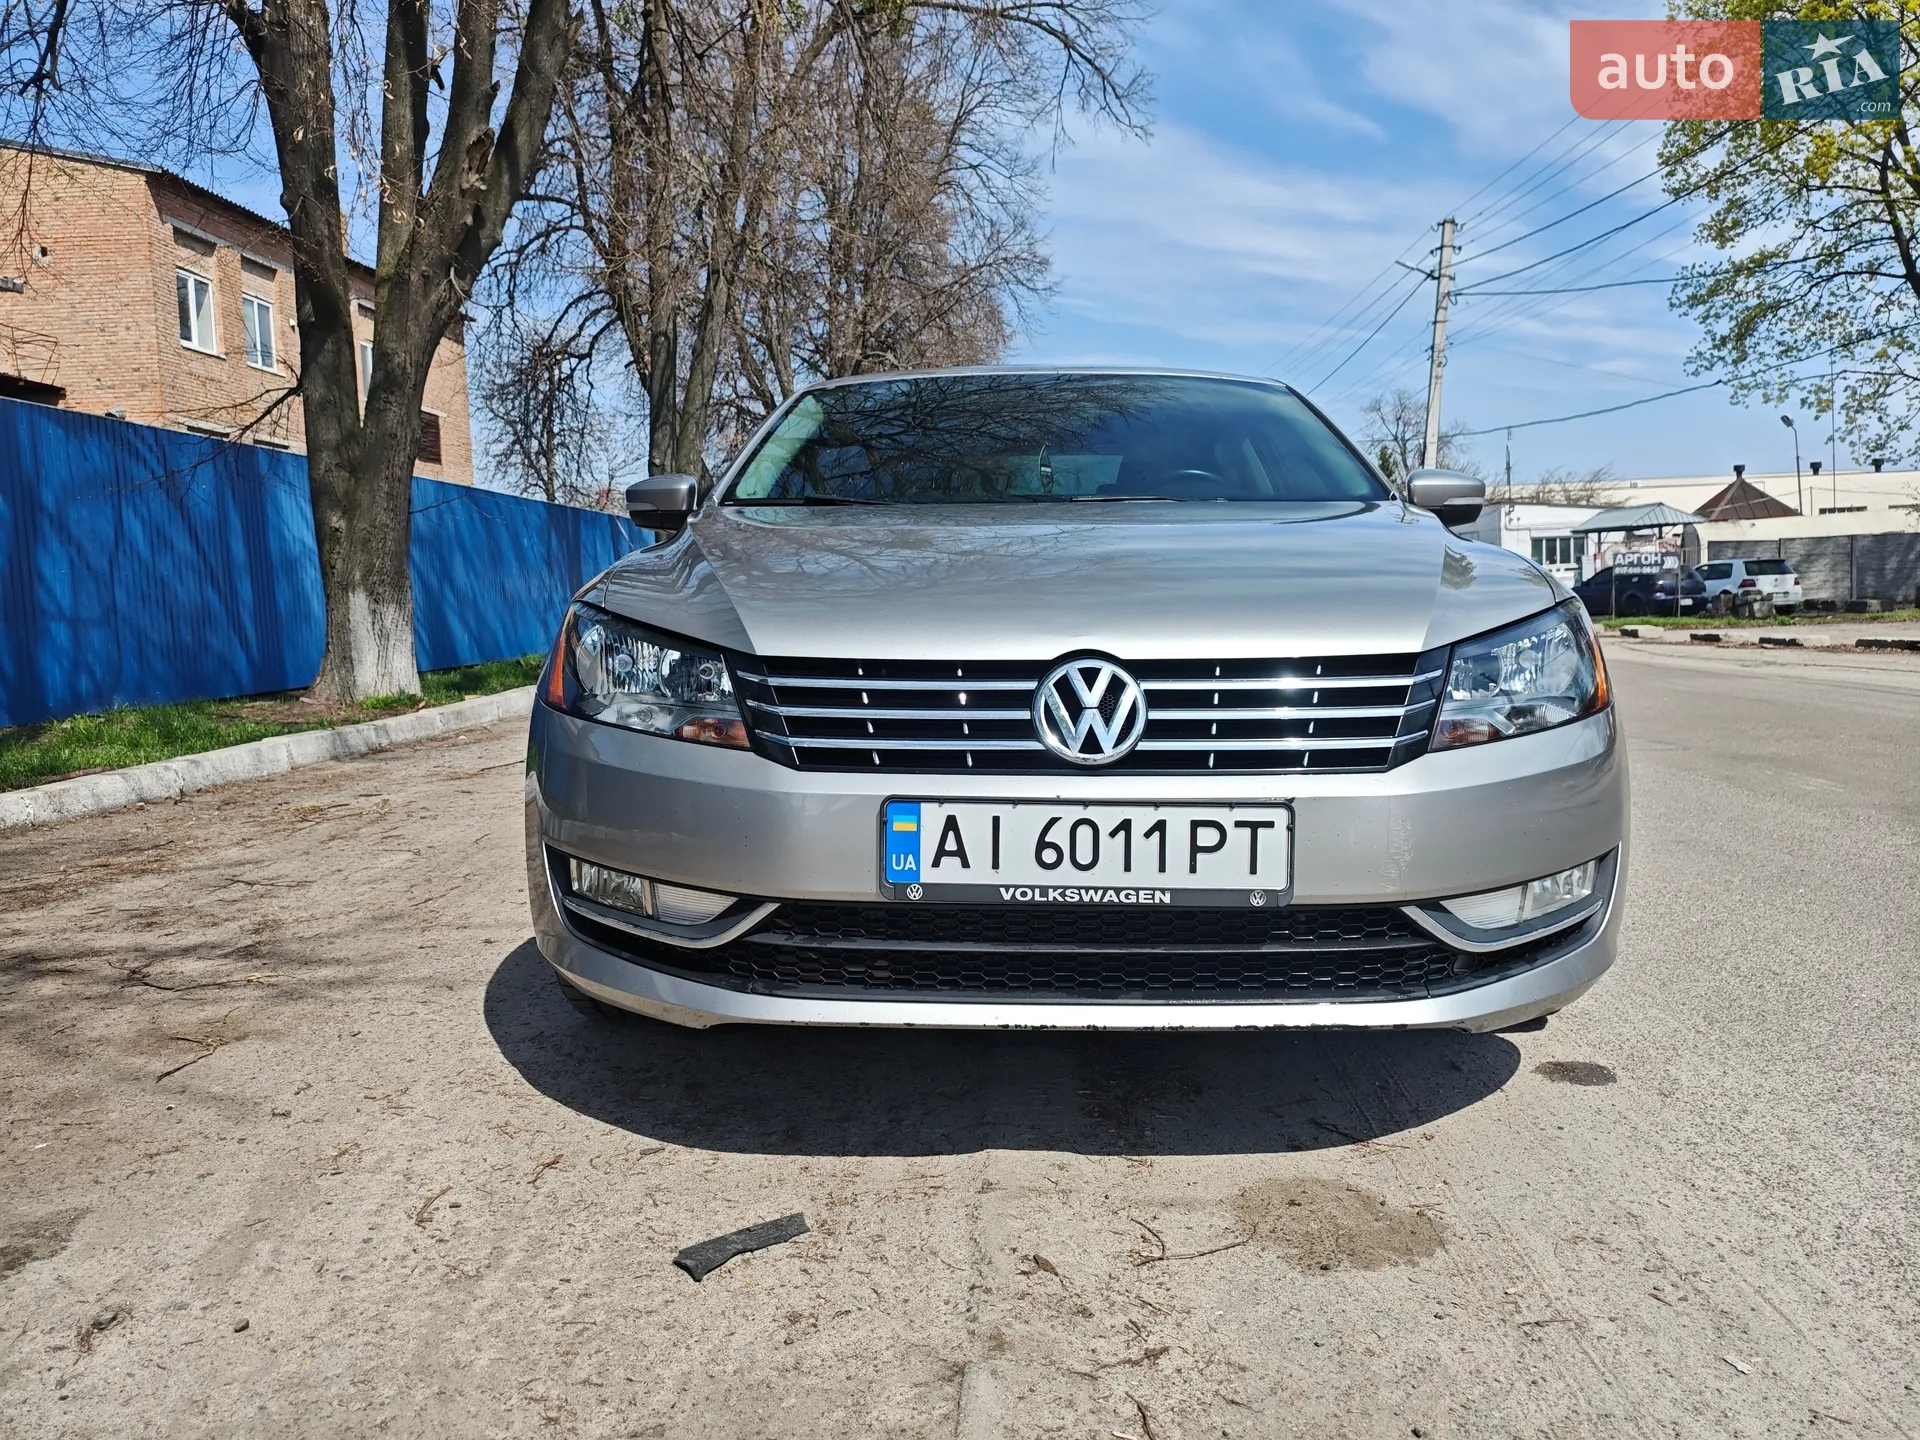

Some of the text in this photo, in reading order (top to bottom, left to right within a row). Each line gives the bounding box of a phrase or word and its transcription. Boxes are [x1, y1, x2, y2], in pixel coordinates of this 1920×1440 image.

[1615, 553, 1661, 565] АРГОН
[1034, 816, 1167, 874] 6011
[892, 853, 917, 871] UA
[999, 887, 1171, 904] VOLKSWAGEN
